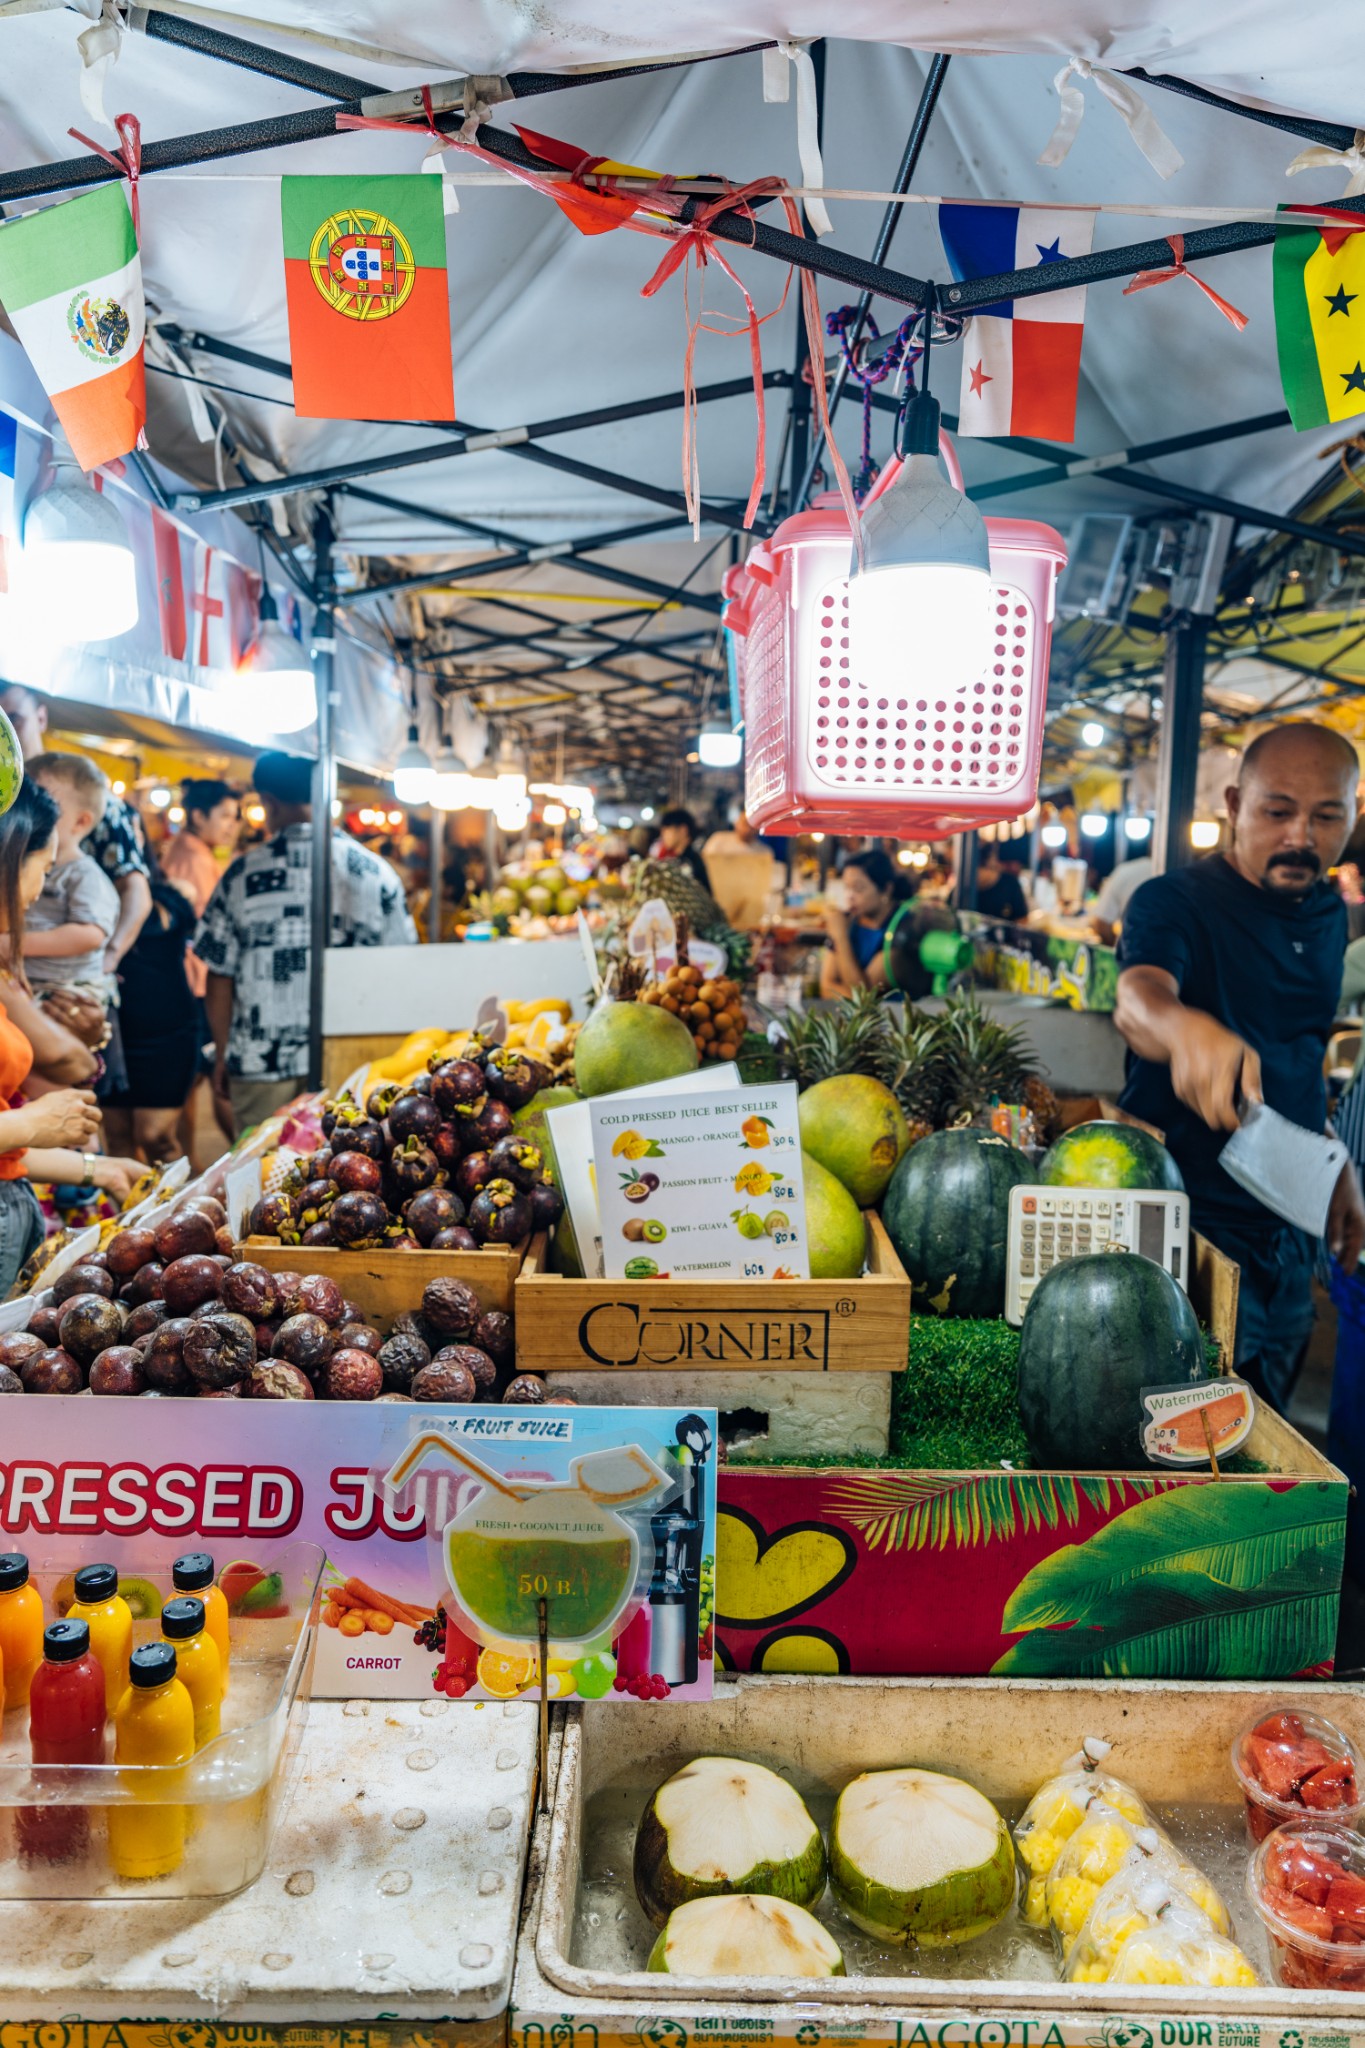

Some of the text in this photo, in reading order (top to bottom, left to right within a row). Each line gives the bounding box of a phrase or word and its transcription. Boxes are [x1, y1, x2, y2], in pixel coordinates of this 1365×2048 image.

[600, 1101, 778, 1126] COLD PRESSED JUICE BEST SELLER
[660, 1135, 695, 1146] MANGO
[702, 1131, 741, 1142] ORANGE
[773, 1136, 786, 1146] 80
[661, 1179, 697, 1189] PASSION
[698, 1176, 723, 1185] FRUIT
[730, 1173, 762, 1183] MANGO
[774, 1186, 786, 1198] 80
[671, 1225, 691, 1233] KIWI
[698, 1222, 728, 1231] GUAVA
[774, 1232, 788, 1244] 80
[673, 1260, 731, 1272] WATERMELON
[578, 1302, 821, 1366] CORNER
[1149, 1385, 1234, 1411] Watermelon
[463, 1418, 514, 1435] FRUIT
[518, 1421, 569, 1438] JUICE
[0, 1462, 300, 1534] RESSED
[475, 1519, 605, 1532] FRESH COCONUT JUICE
[519, 1573, 576, 1596] 50 B.
[346, 1656, 402, 1670] CARROT
[887, 2020, 1067, 2048] JAGOTA
[1160, 2021, 1213, 2046] OUR
